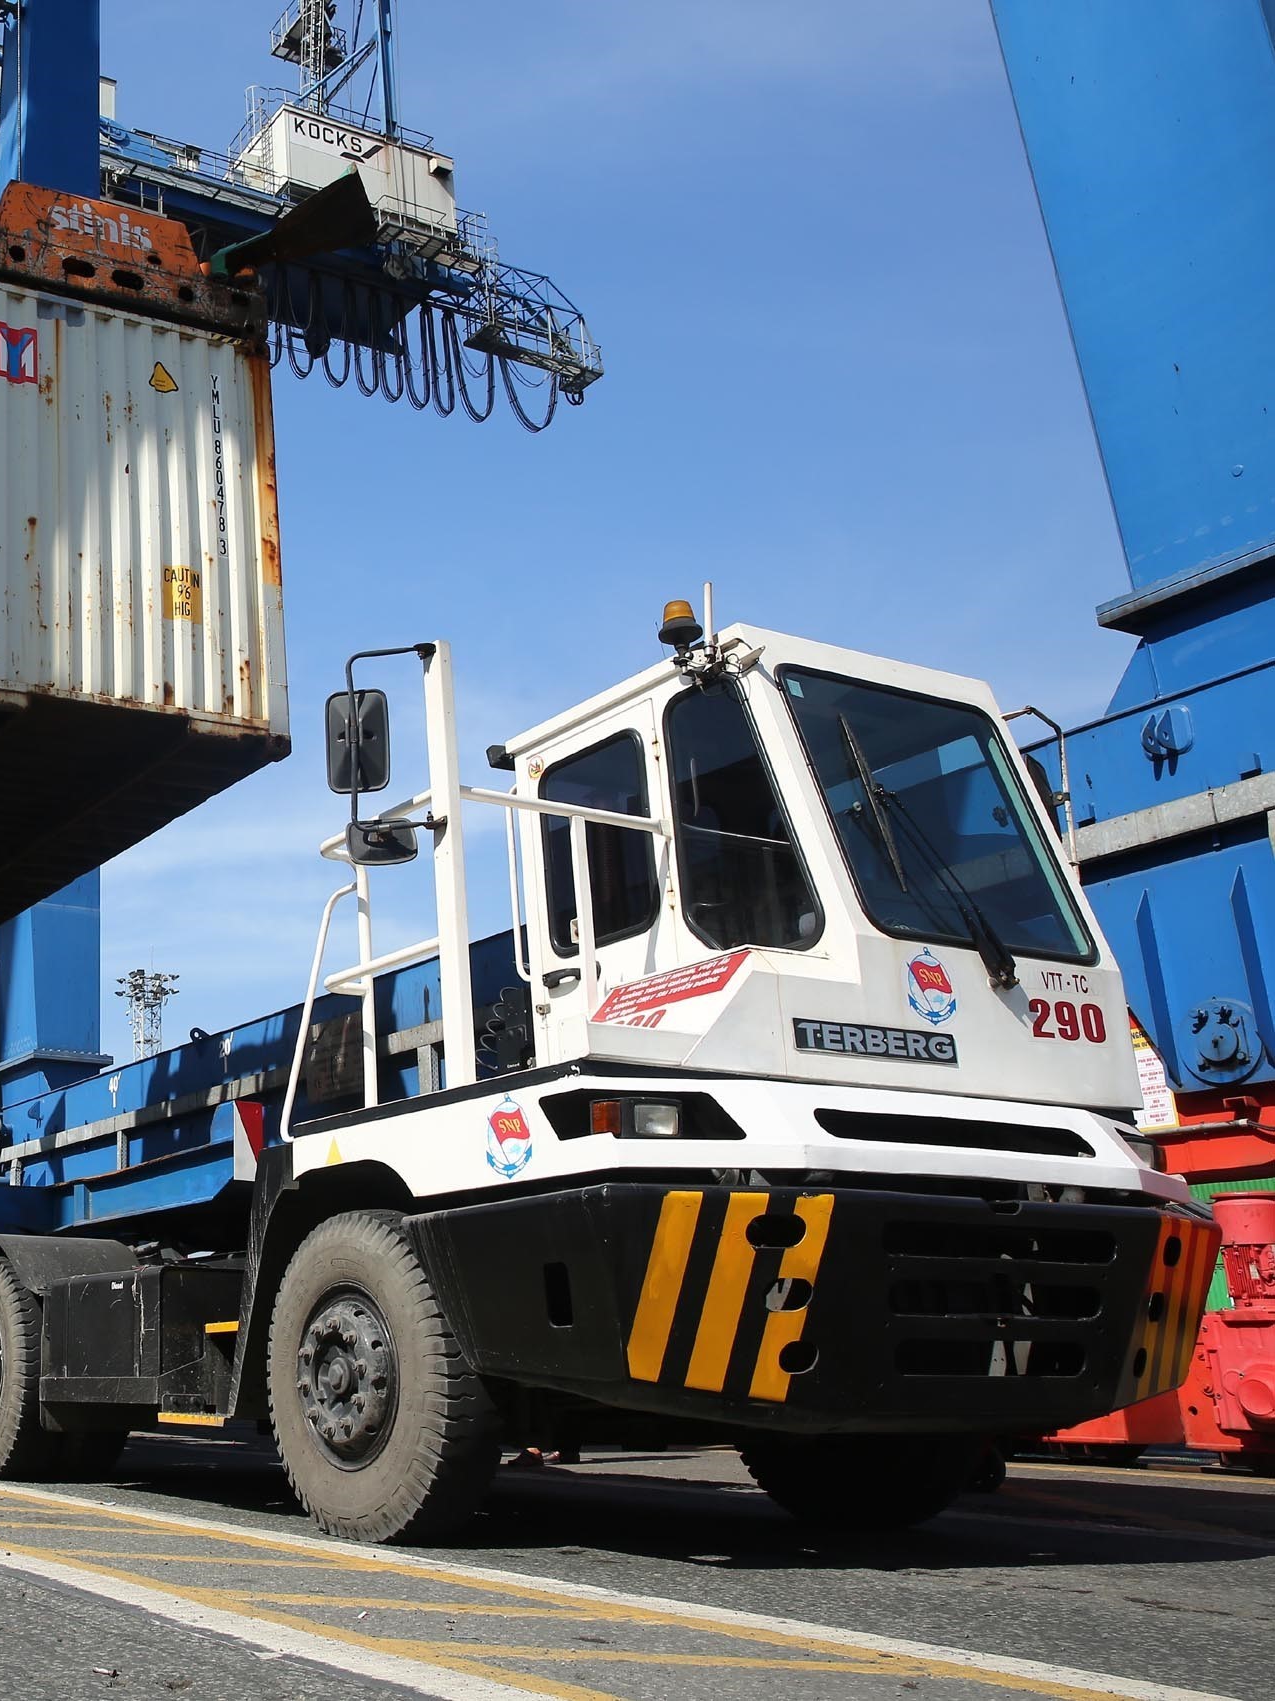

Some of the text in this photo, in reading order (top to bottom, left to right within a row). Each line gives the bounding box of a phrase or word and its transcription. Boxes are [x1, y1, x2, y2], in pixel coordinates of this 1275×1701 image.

[293, 117, 362, 153] KOCKS
[47, 203, 153, 249] stinis
[209, 374, 227, 555] YMLU 860478 3
[918, 967, 945, 987] SNP
[1028, 997, 1107, 1044] 290
[796, 1021, 954, 1060] TERBERG
[497, 1118, 522, 1134] SNP
